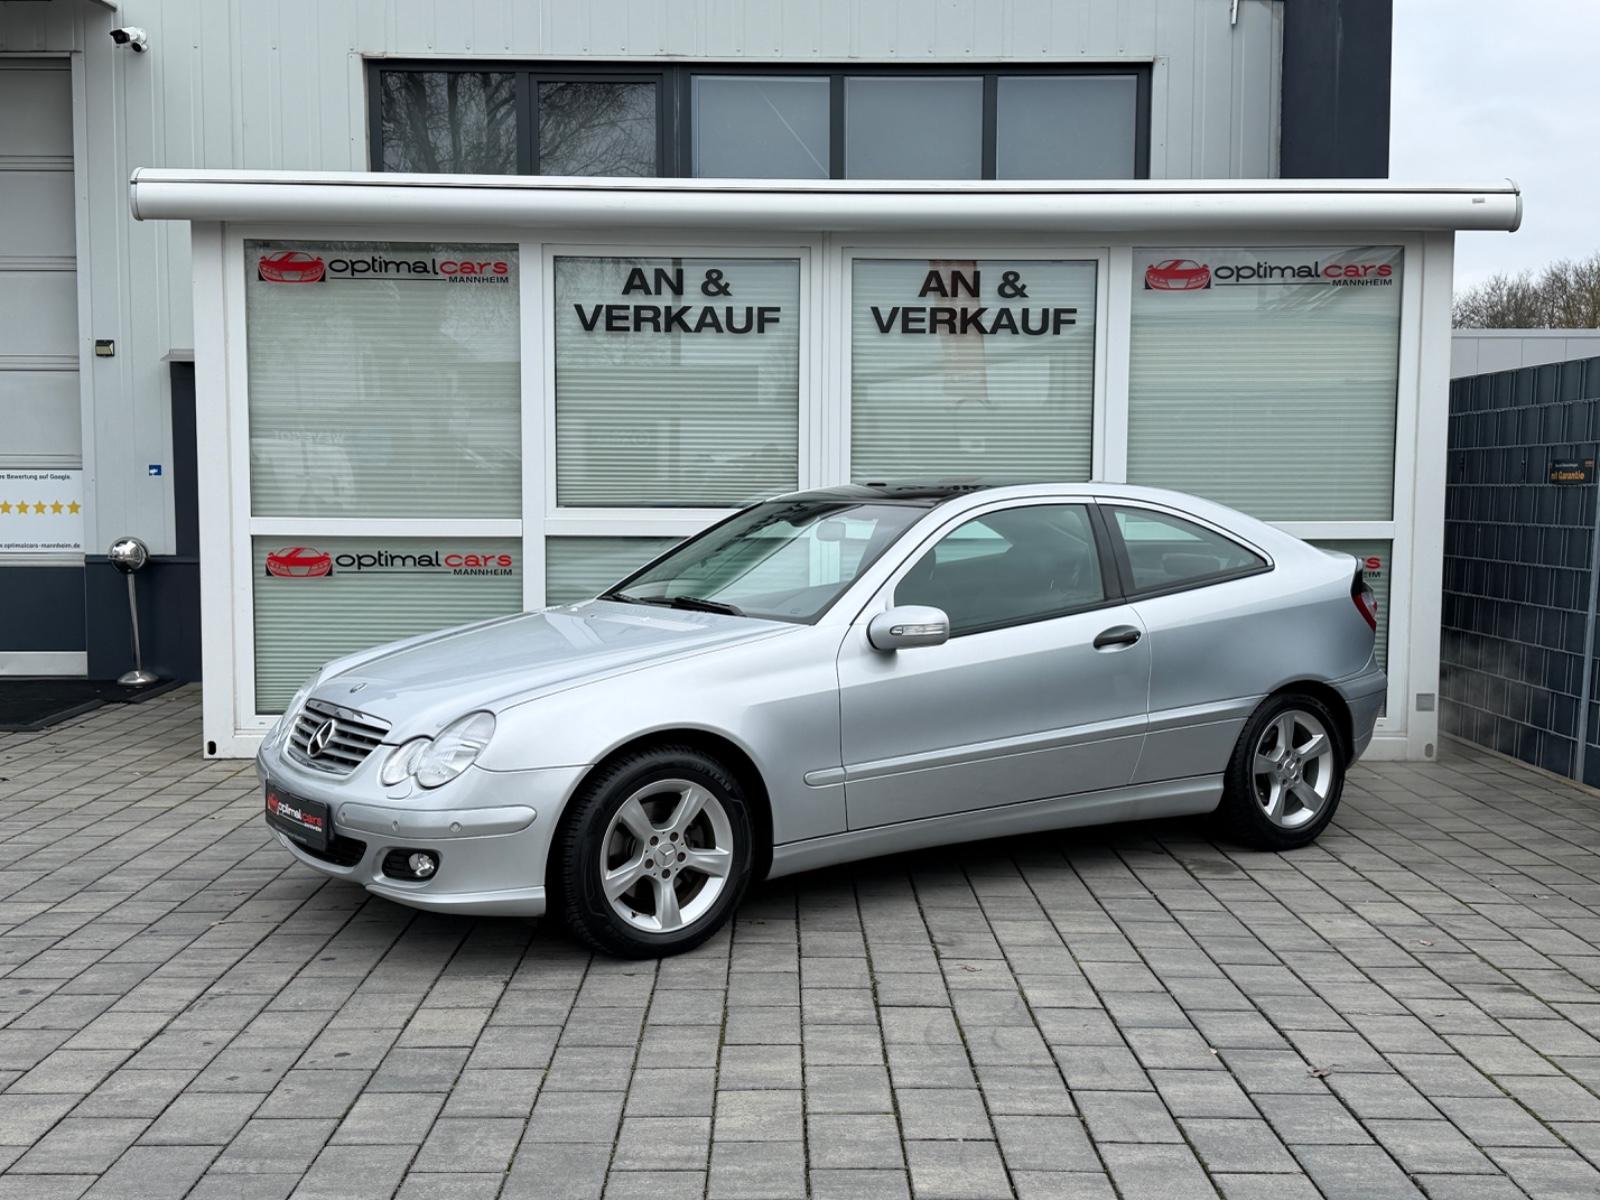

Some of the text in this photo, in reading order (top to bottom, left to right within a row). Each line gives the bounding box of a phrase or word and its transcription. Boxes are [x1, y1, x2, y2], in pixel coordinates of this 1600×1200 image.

[448, 276, 509, 284] MANNHEIM
[621, 267, 733, 297] AN &
[918, 270, 1029, 299] AN &
[1332, 279, 1393, 287] MANNHEIM
[573, 303, 782, 334] VERKAUF
[870, 306, 1078, 336] VERKAUF
[453, 568, 513, 576] MANNHEIM
